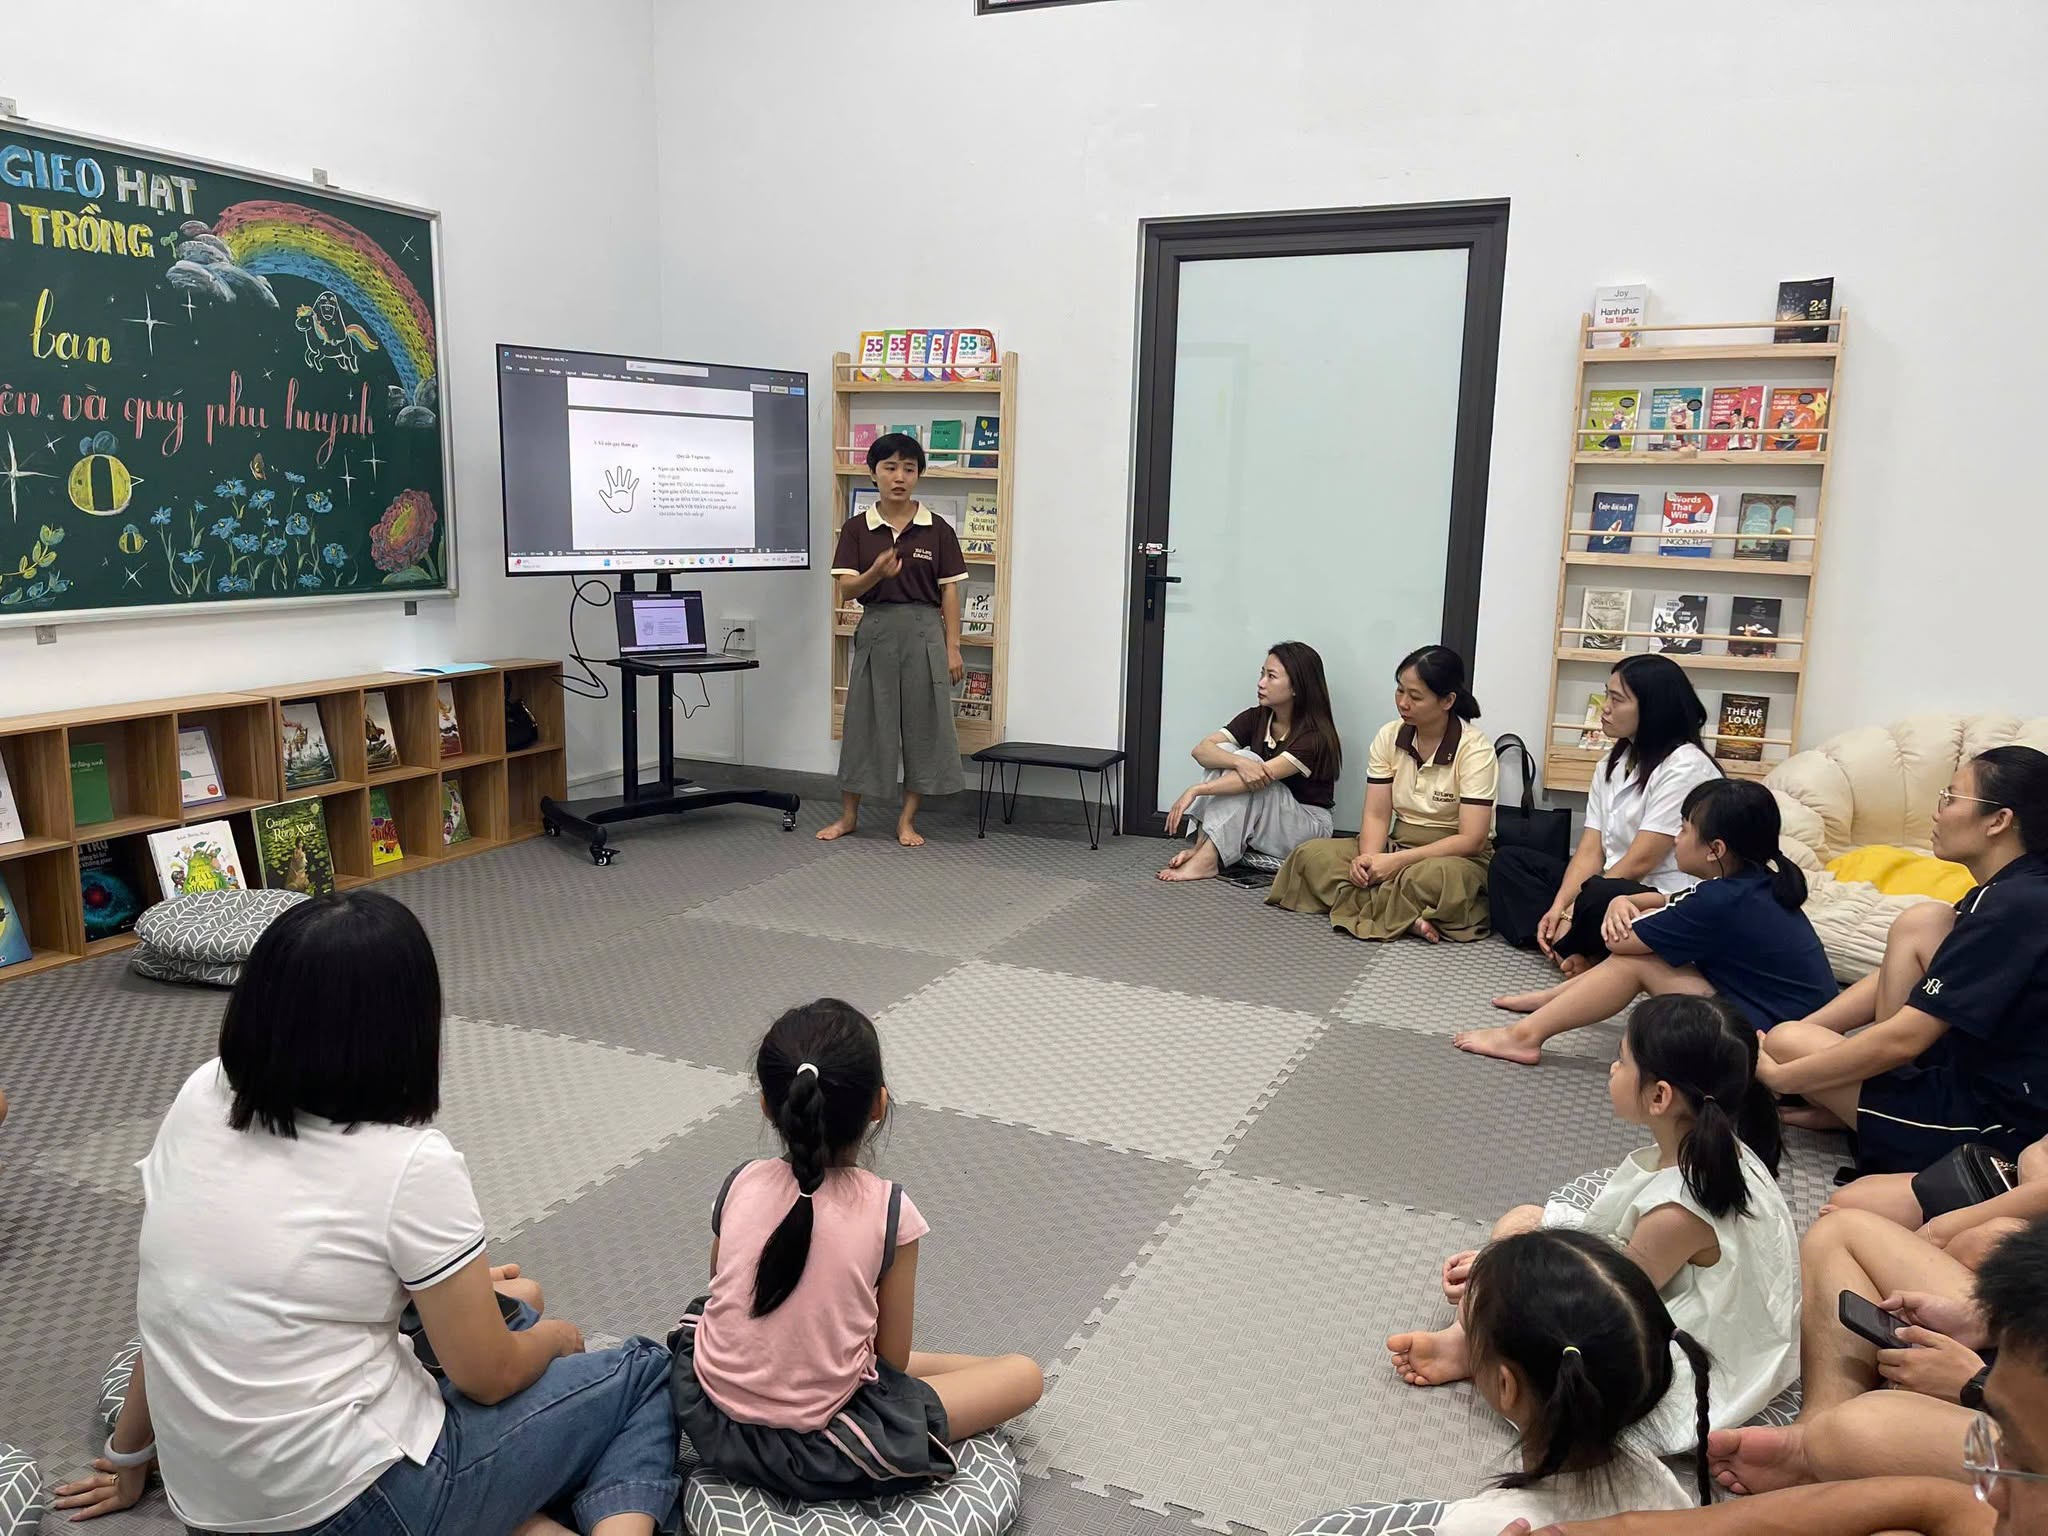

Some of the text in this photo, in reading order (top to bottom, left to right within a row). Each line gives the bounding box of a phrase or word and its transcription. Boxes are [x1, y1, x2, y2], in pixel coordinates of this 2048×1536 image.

[0, 145, 197, 215] GIEO HẠT
[18, 203, 155, 258] TRỒNG
[1809, 299, 1827, 311] 24
[30, 288, 112, 368] bạn
[866, 339, 883, 352] 55
[890, 338, 906, 351] 55
[960, 336, 977, 350] 55
[60, 384, 109, 421] và
[124, 388, 188, 457] quý
[207, 371, 269, 446] phụ
[285, 377, 375, 465] huynh
[1672, 503, 1692, 511] That
[1729, 716, 1742, 724] LO
